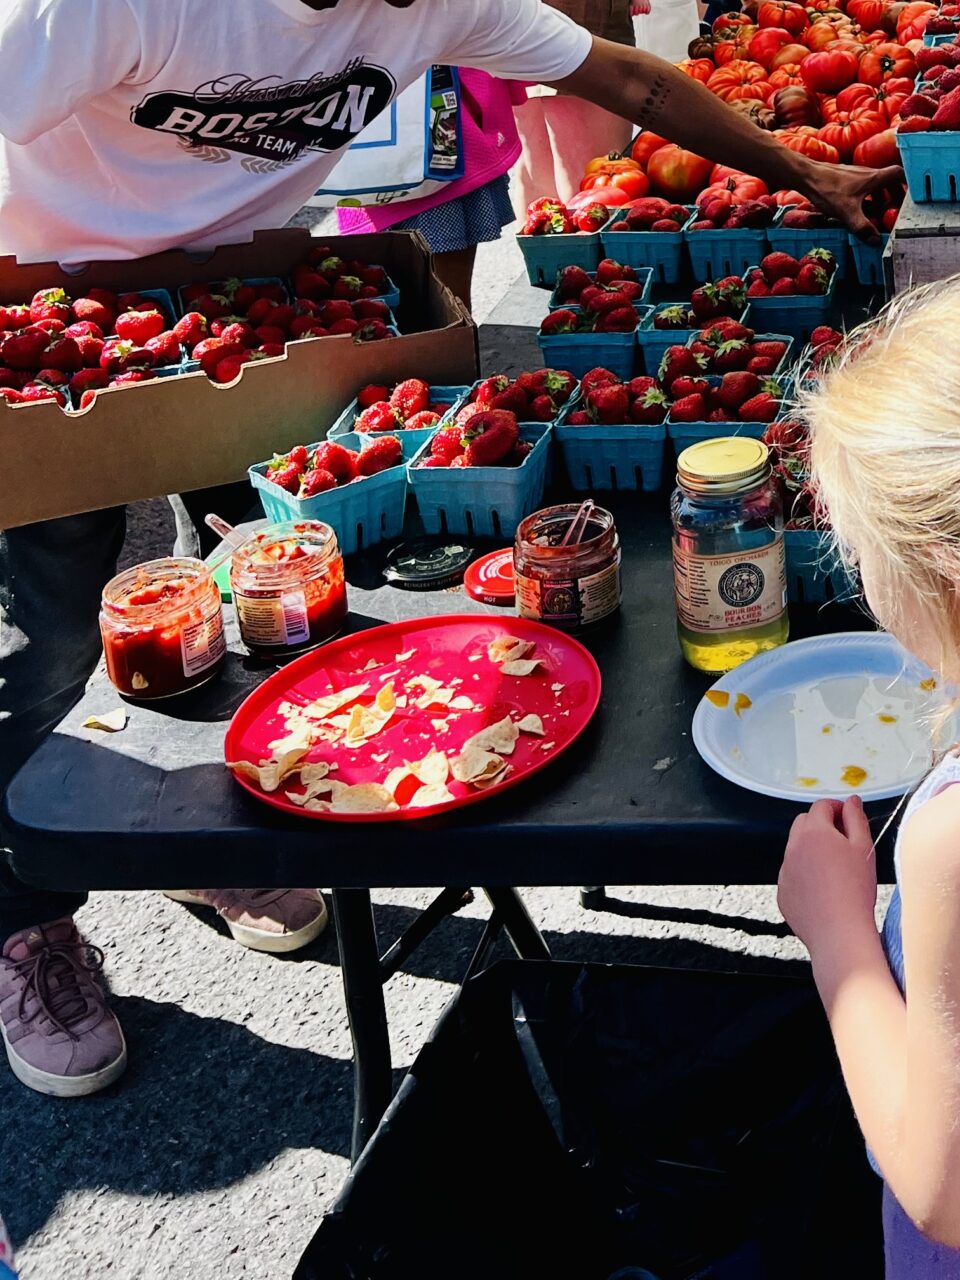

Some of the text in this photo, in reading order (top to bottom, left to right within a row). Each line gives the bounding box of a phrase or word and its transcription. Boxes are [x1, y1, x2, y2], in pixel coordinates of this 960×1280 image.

[155, 84, 376, 140] BOSTON
[256, 134, 297, 155] TEAM
[483, 595, 497, 603] HOT
[724, 604, 762, 617] BOURBON
[725, 610, 763, 623] PEACHES
